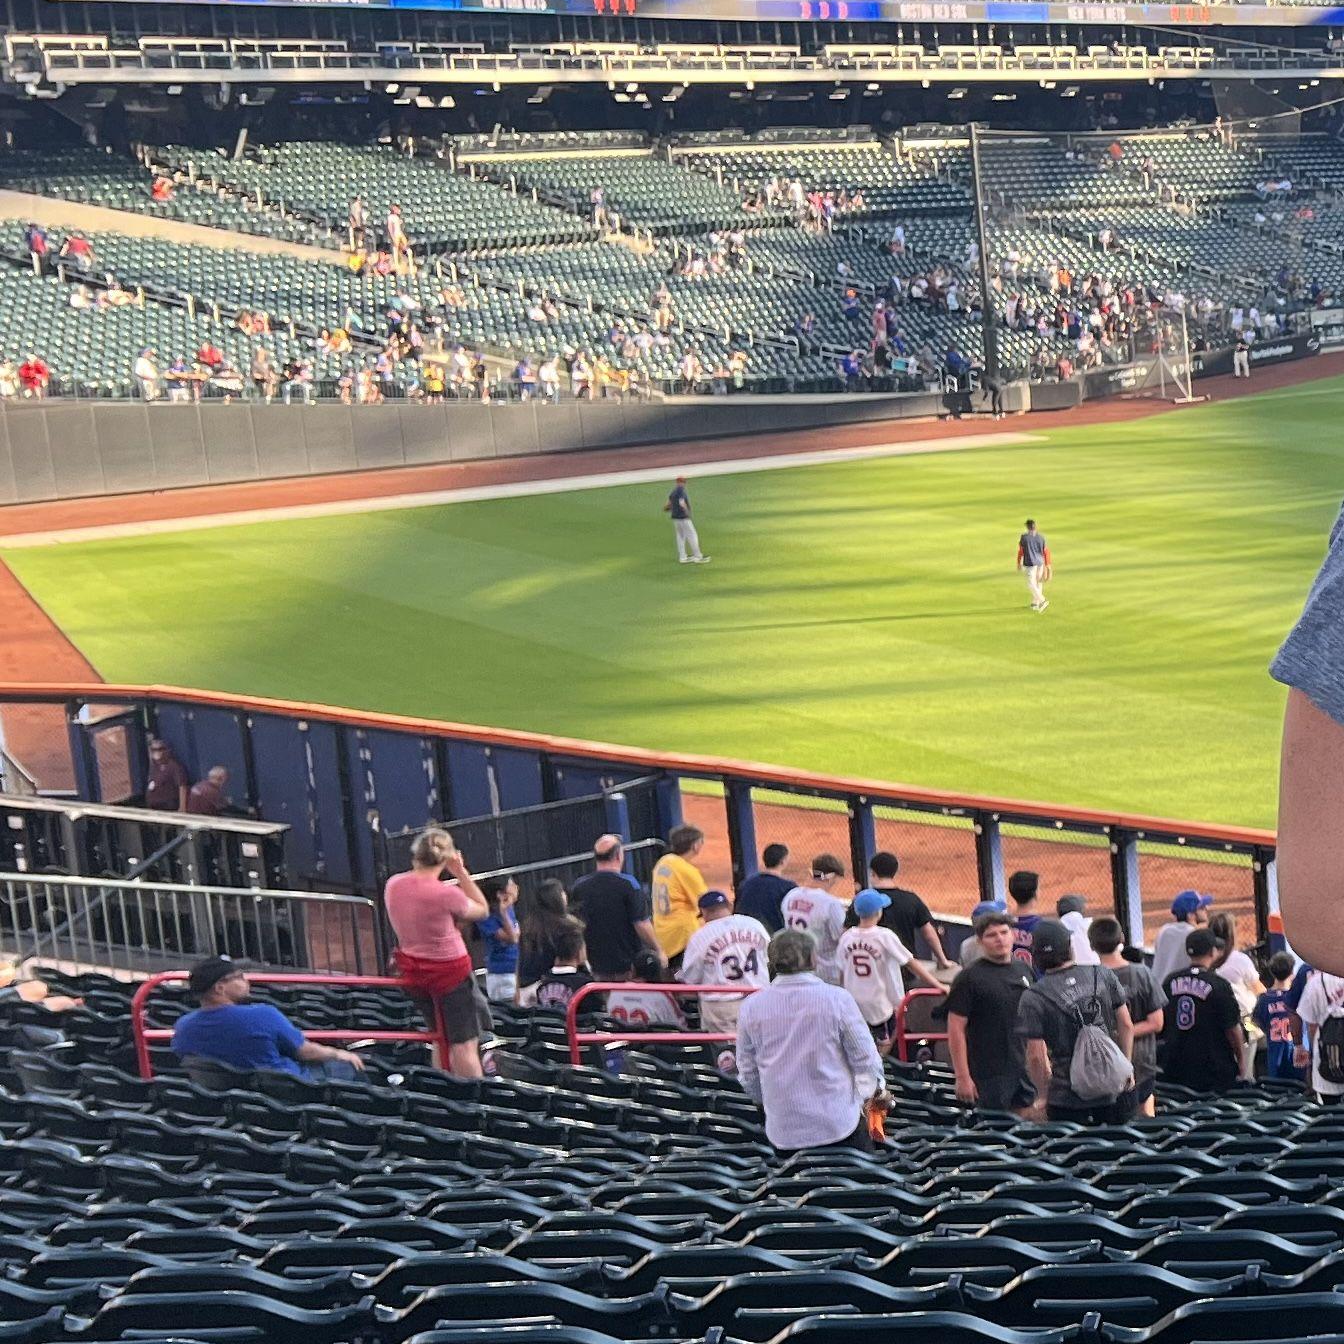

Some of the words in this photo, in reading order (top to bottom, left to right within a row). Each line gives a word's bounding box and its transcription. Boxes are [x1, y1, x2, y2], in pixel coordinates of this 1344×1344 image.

[721, 947, 759, 980] 34
[853, 955, 872, 977] 5
[1176, 995, 1196, 1031] 8
